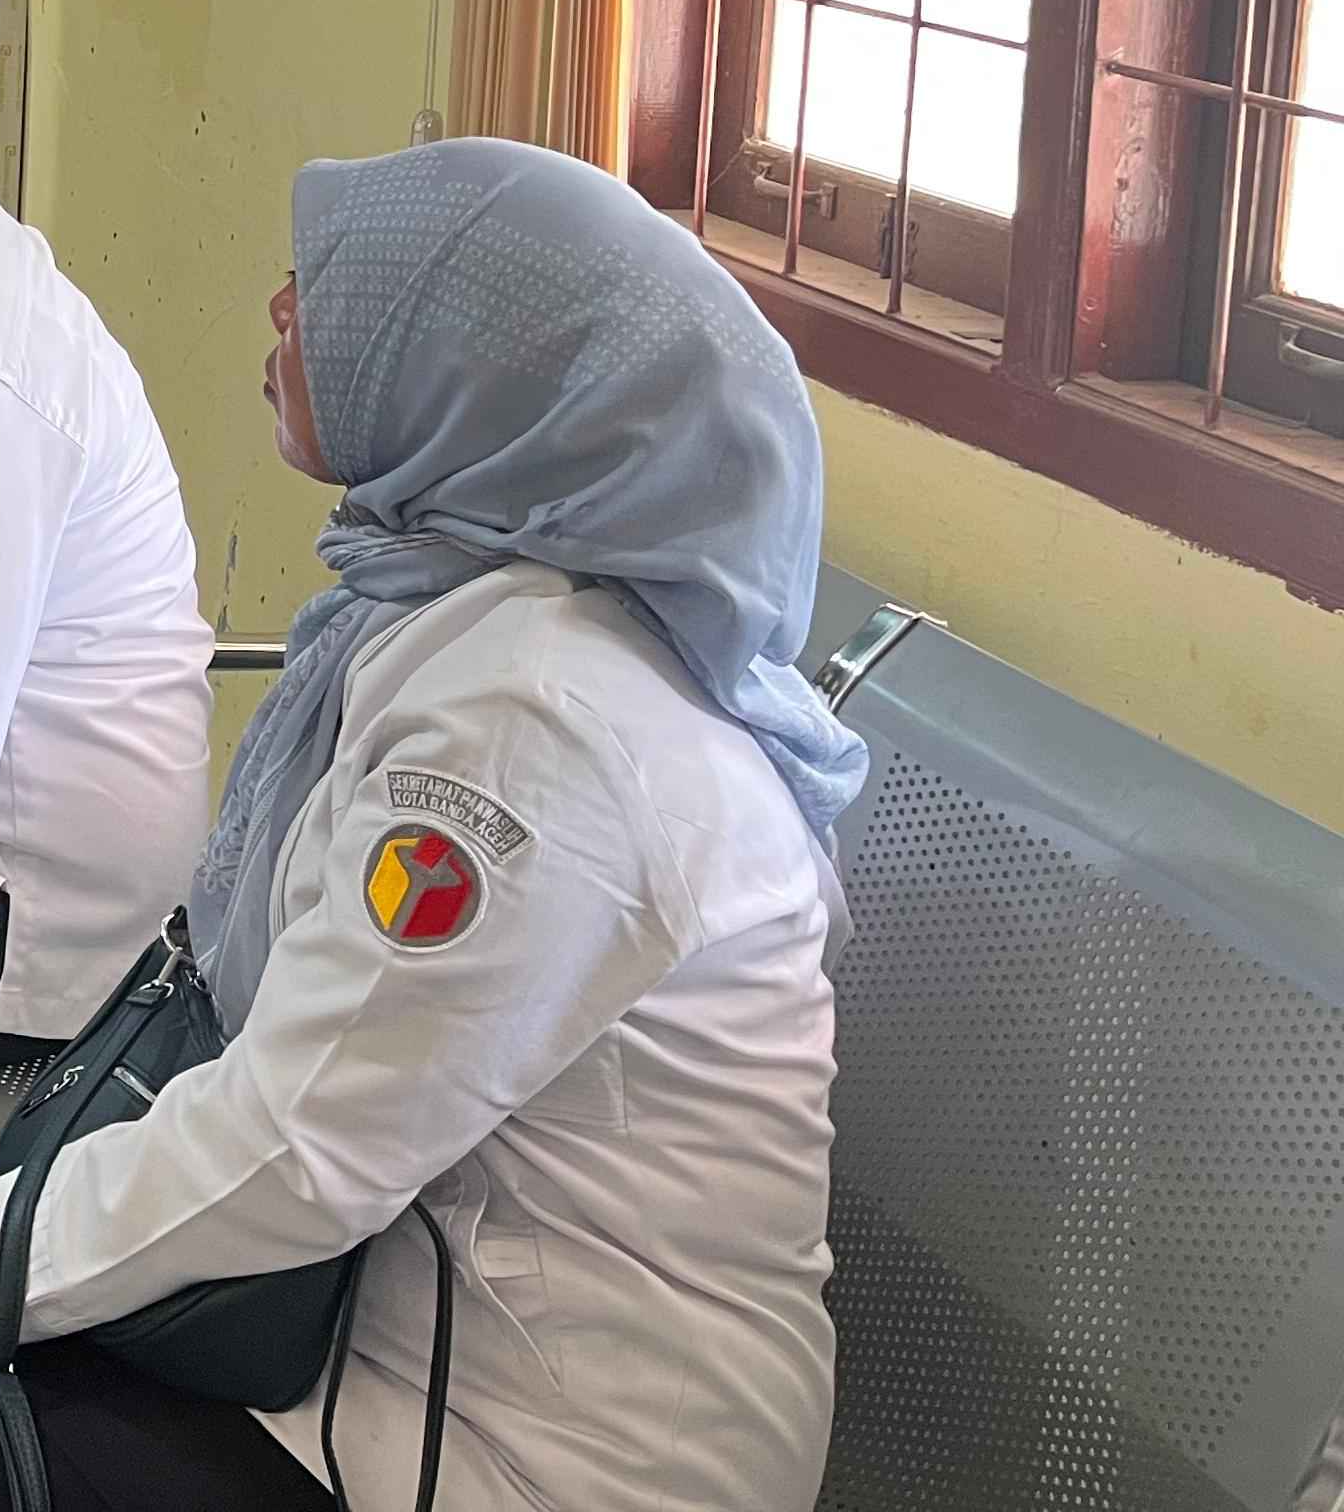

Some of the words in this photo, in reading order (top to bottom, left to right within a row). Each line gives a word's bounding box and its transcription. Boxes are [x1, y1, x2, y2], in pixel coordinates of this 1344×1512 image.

[389, 774, 462, 801] SEKRETARIAT
[458, 790, 524, 844] PANWASLIH
[392, 791, 427, 808] KOTA
[429, 797, 475, 829] BANDA
[475, 821, 512, 855] ACEH
